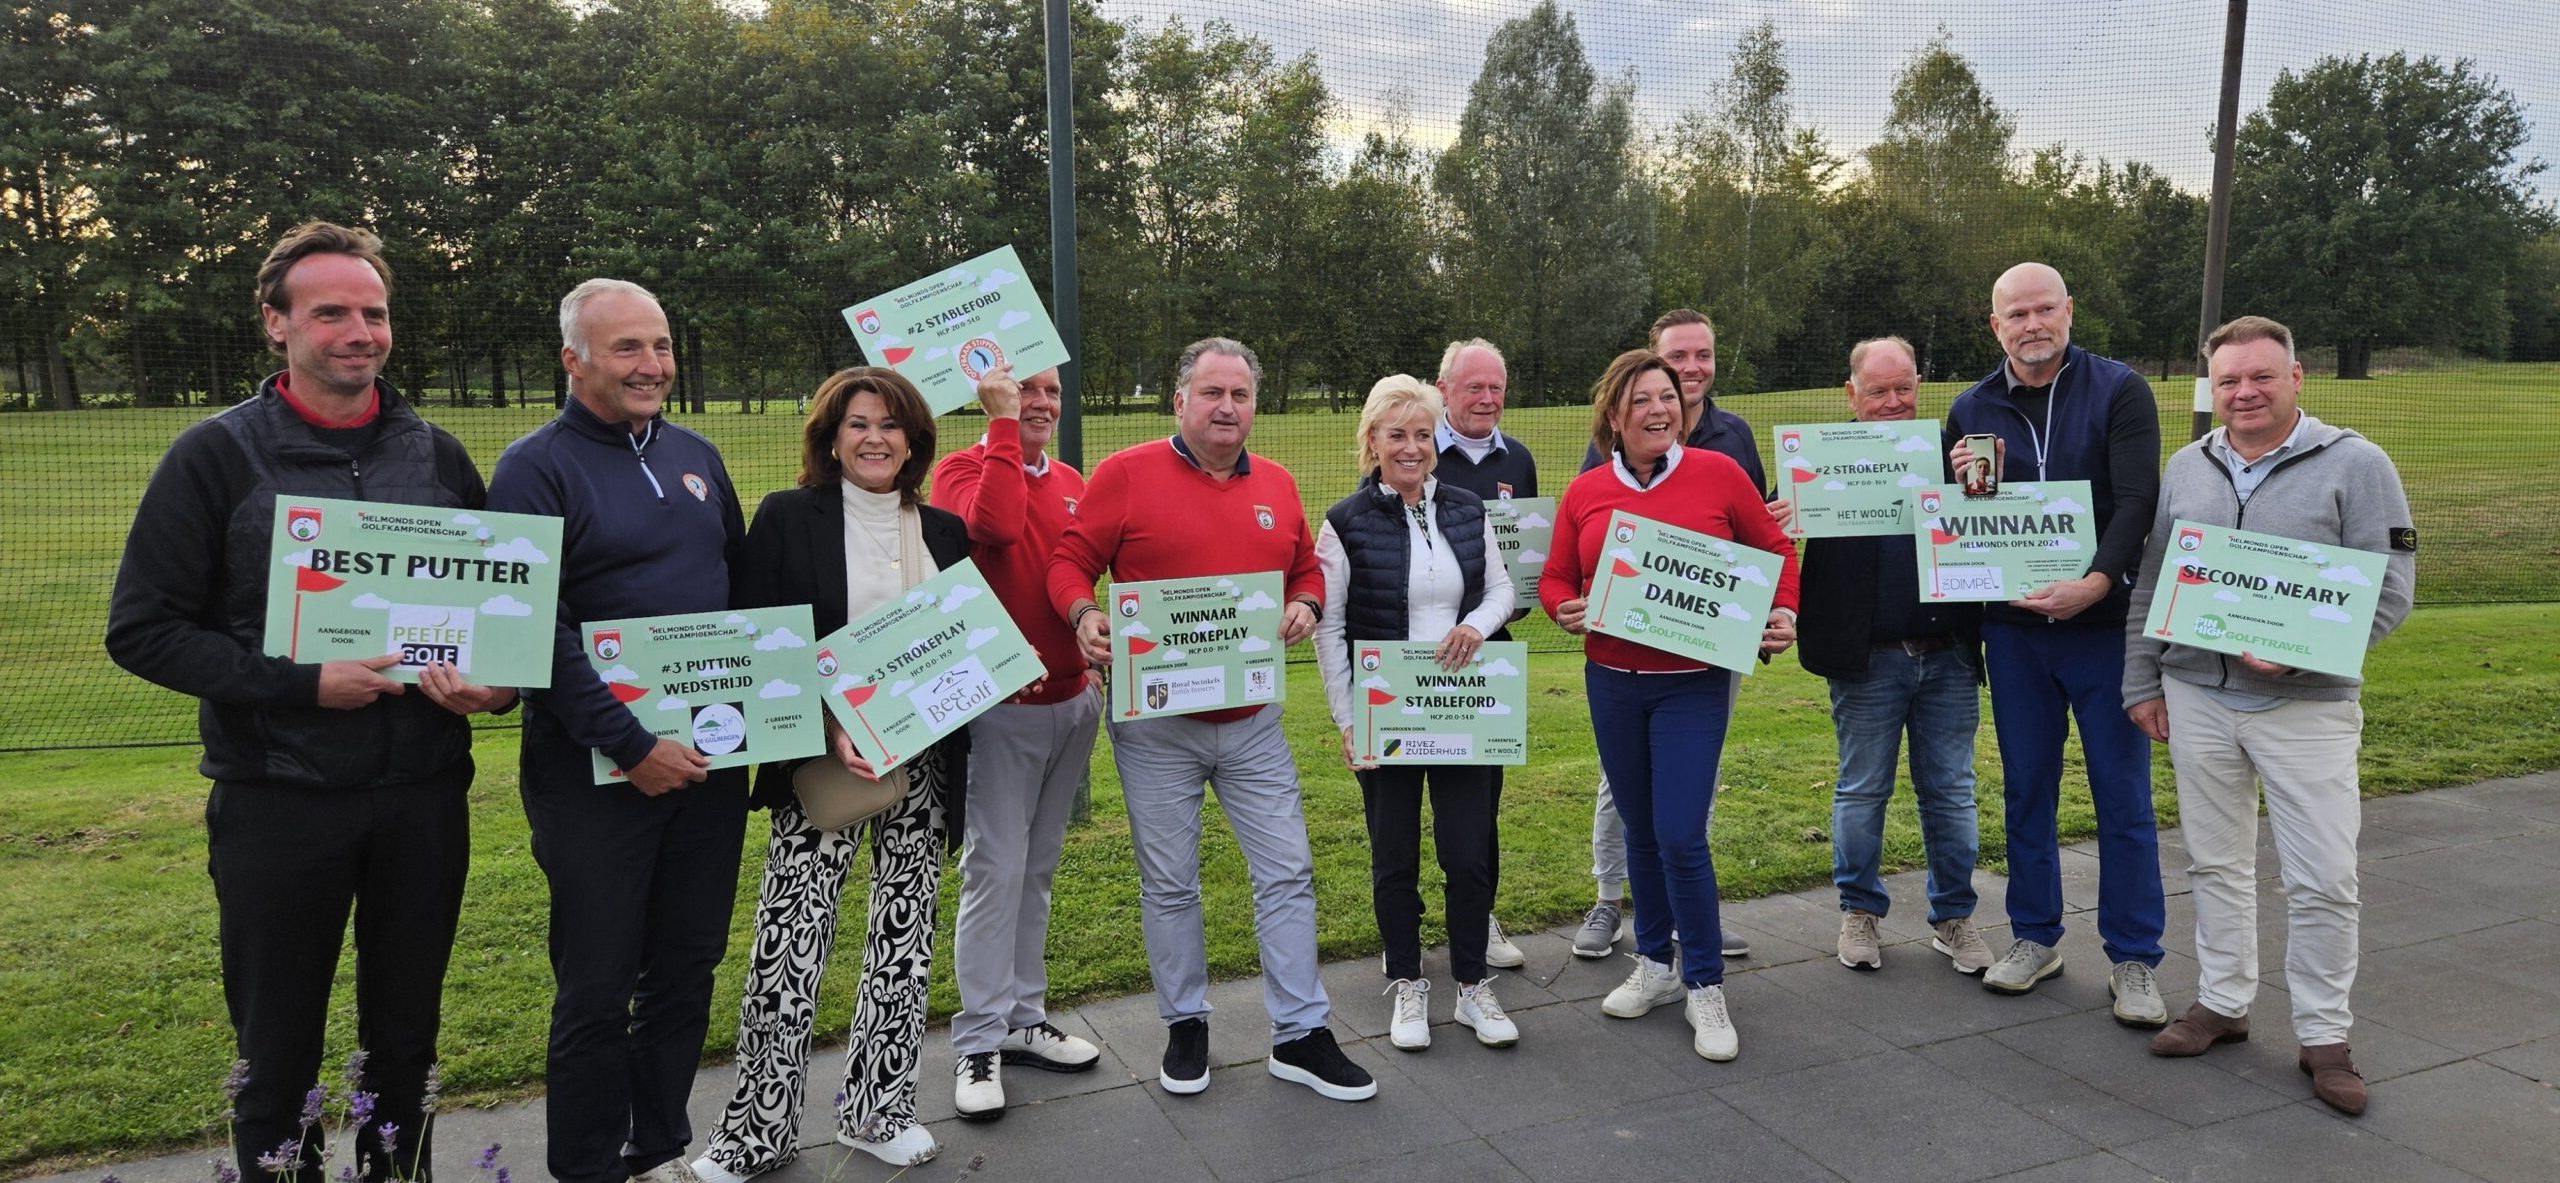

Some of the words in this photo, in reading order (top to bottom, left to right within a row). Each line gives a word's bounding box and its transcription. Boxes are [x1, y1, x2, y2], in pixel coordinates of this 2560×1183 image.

[929, 282, 945, 291] OPEN
[908, 323, 925, 335] #2
[925, 291, 1001, 329] STABLEFORD
[937, 327, 950, 337] HCP
[960, 344, 977, 379] GOLFBAAN
[1815, 466, 1830, 475] #2
[1834, 462, 1909, 475] STROKEPLAY
[1837, 510, 1857, 519] HET
[1860, 508, 1898, 519] WOOLD
[362, 515, 414, 525] HELMONDS
[416, 519, 441, 527] OPEN
[1939, 513, 2076, 536] WINNAAR
[361, 523, 467, 537] GOLFKAMPIOENSCHAP
[1492, 524, 1519, 534] TING
[1691, 540, 1706, 548] OPEN
[1960, 541, 2009, 549] HELMONDS
[2011, 540, 2035, 548] OPEN
[2037, 539, 2060, 547] 2024
[2231, 537, 2268, 548] HELMONDS
[2270, 544, 2289, 552] OPEN
[2229, 543, 2308, 560] GOLFKAMPIOENSCHAP
[310, 548, 396, 577] BEST
[407, 555, 530, 585] PUTTER
[1642, 551, 1741, 592] LONGEST
[2183, 564, 2268, 591] SECOND
[2274, 581, 2351, 607] NEARY
[1645, 583, 1721, 618] DAMES
[853, 617, 887, 638] HELMONDS
[886, 607, 904, 619] OPEN
[1170, 607, 1237, 625] WINNAAR
[1625, 610, 1644, 621] PIN
[2195, 617, 2218, 628] PIN
[2227, 612, 2266, 624] AANGEBODEN
[652, 624, 695, 634] HELMONDS
[696, 623, 717, 631] OPEN
[857, 603, 922, 644] GOLFKAMPIOENSCHAP
[1624, 618, 1650, 631] HIGH
[318, 627, 371, 636] AANGEBODEN
[393, 626, 468, 644] PEETEE
[653, 629, 738, 641] GOLFKAMPIOENSCHAP
[1163, 627, 1248, 647] STROKEPLAY
[2195, 625, 2226, 637] HIGH
[1648, 625, 1719, 652] GOLFTRAVEL
[2225, 631, 2312, 655] GOLFTRAVEL
[402, 646, 456, 664] GOLF
[867, 668, 886, 684] #3
[887, 620, 967, 673] STROKEPLAY
[1189, 647, 1202, 655] HCP
[661, 662, 682, 674] #3
[686, 655, 752, 672] PUTTING
[910, 665, 924, 678] HCP
[939, 649, 953, 660] 19.9
[663, 675, 753, 695] WEDSTRIJD
[1172, 680, 1190, 688] Royal
[1416, 675, 1486, 688] WINNAAR
[955, 680, 992, 711] Golf
[1406, 696, 1496, 708] STABLEFORD
[927, 687, 967, 723] Best
[770, 714, 803, 723] GREENFEES
[778, 723, 797, 731] HOLES
[1406, 740, 1435, 748] RIVEZ
